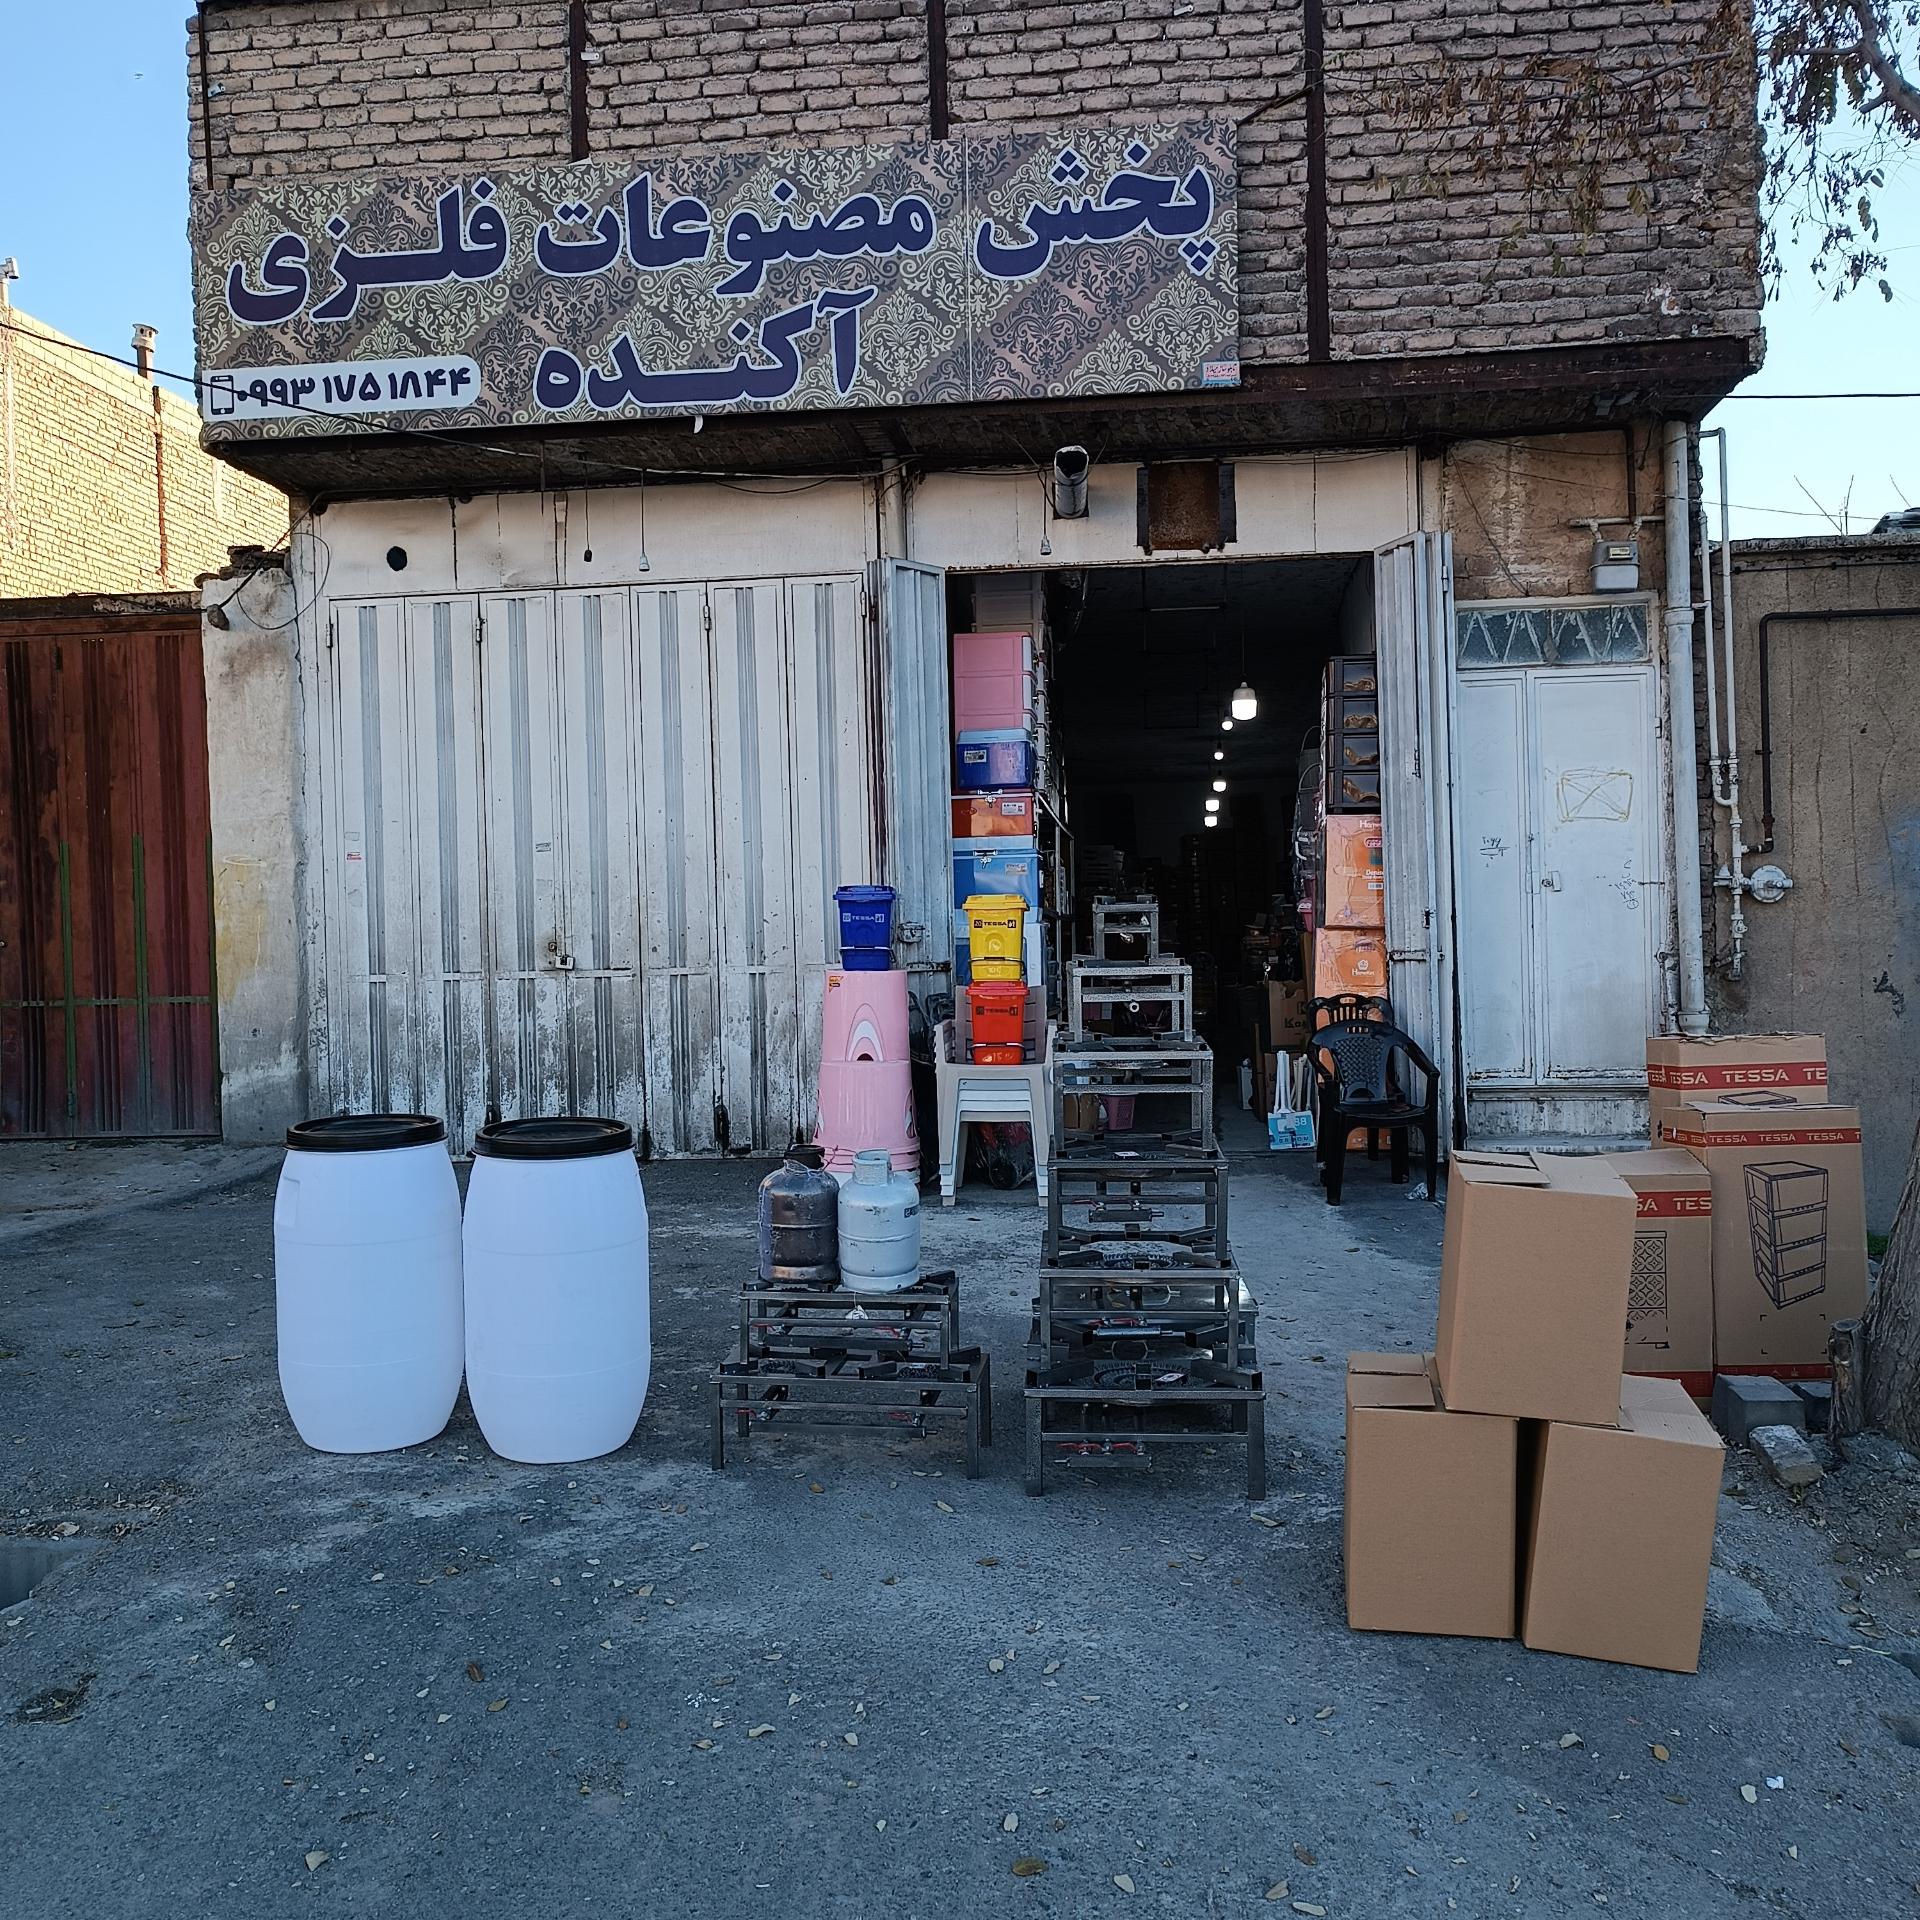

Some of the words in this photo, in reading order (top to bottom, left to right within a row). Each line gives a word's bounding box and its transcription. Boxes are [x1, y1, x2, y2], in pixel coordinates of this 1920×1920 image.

[227, 177, 510, 326] فلزی
[534, 171, 935, 298] مصنوعات
[972, 139, 1219, 280] پخش
[533, 286, 878, 411] آکنده
[1670, 1071, 1709, 1085] TESSA
[1721, 1069, 1790, 1083] TESSA
[1803, 1067, 1827, 1080] TE
[1709, 1135, 1748, 1143] TESSA
[1759, 1133, 1796, 1142] TESSA
[1806, 1132, 1844, 1141] TESSA
[1673, 1197, 1712, 1211] TES
